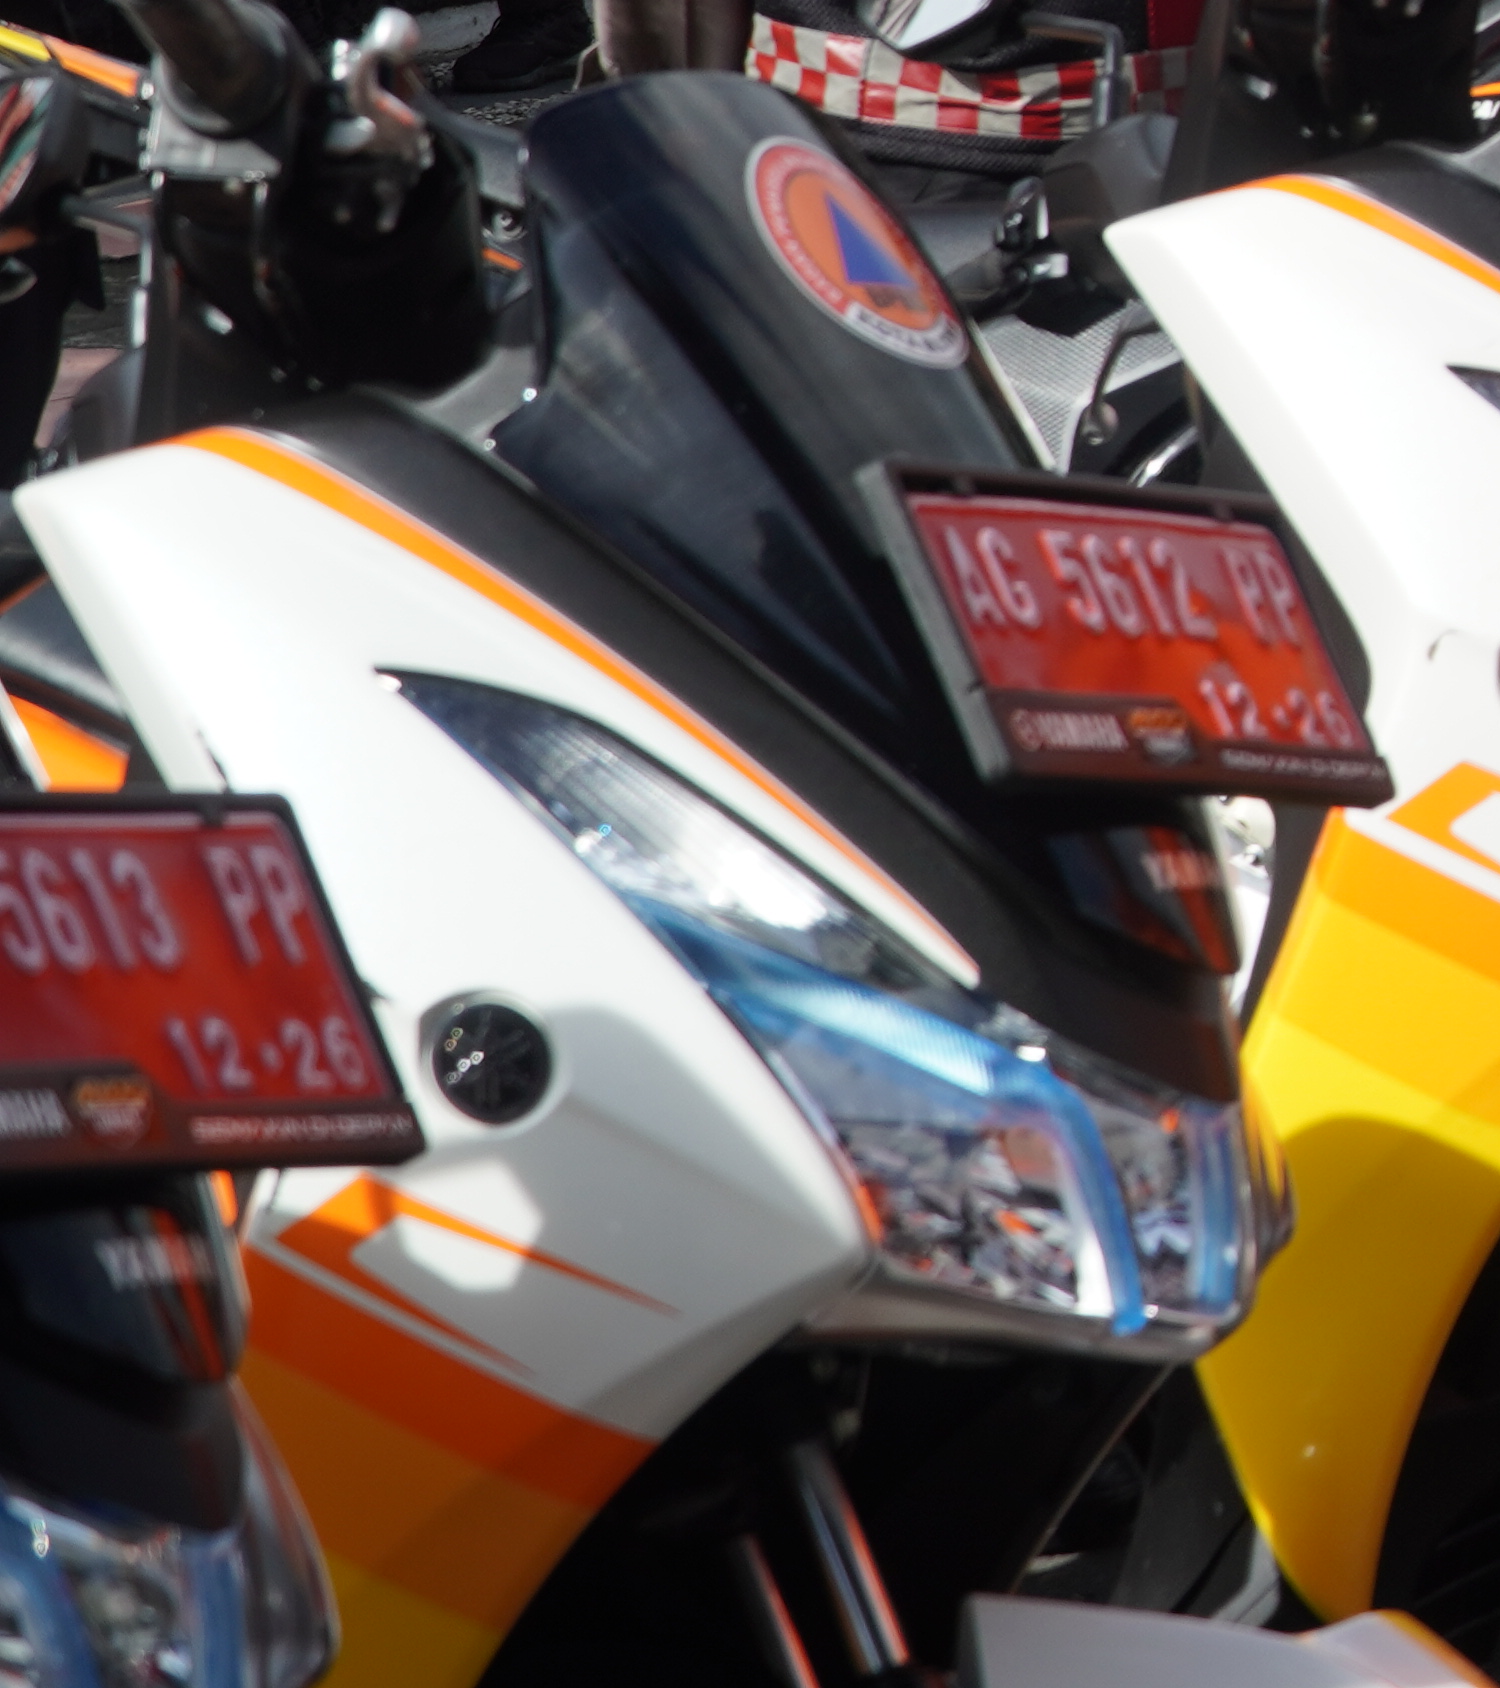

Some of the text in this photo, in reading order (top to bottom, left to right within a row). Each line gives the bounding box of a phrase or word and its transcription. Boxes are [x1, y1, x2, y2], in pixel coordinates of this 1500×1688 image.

[942, 524, 1301, 648] AG 5612 PP
[0, 843, 306, 977] 5613 PP
